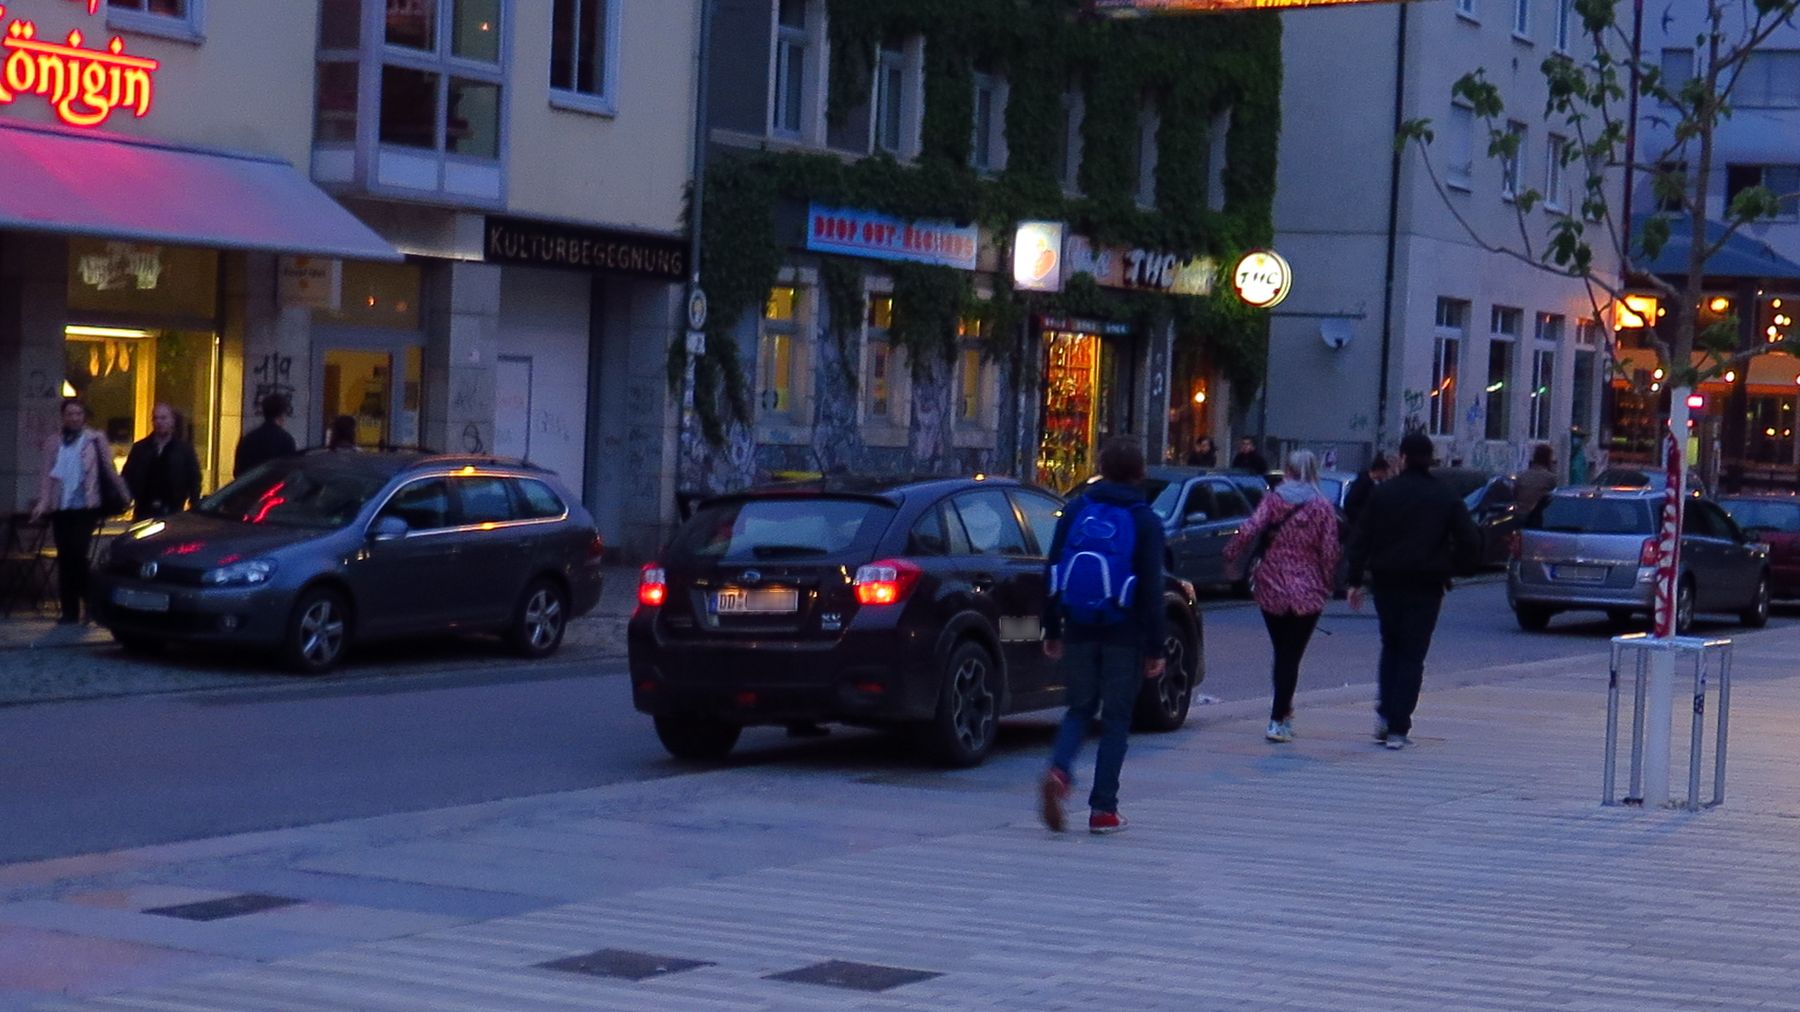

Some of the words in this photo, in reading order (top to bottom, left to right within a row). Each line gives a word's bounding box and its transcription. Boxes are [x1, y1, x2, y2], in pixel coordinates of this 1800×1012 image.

[0, 18, 158, 126] önigin
[489, 224, 683, 275] KULTURBEGEGNUNG
[815, 216, 857, 241] DROP
[1125, 248, 1177, 288] THC
